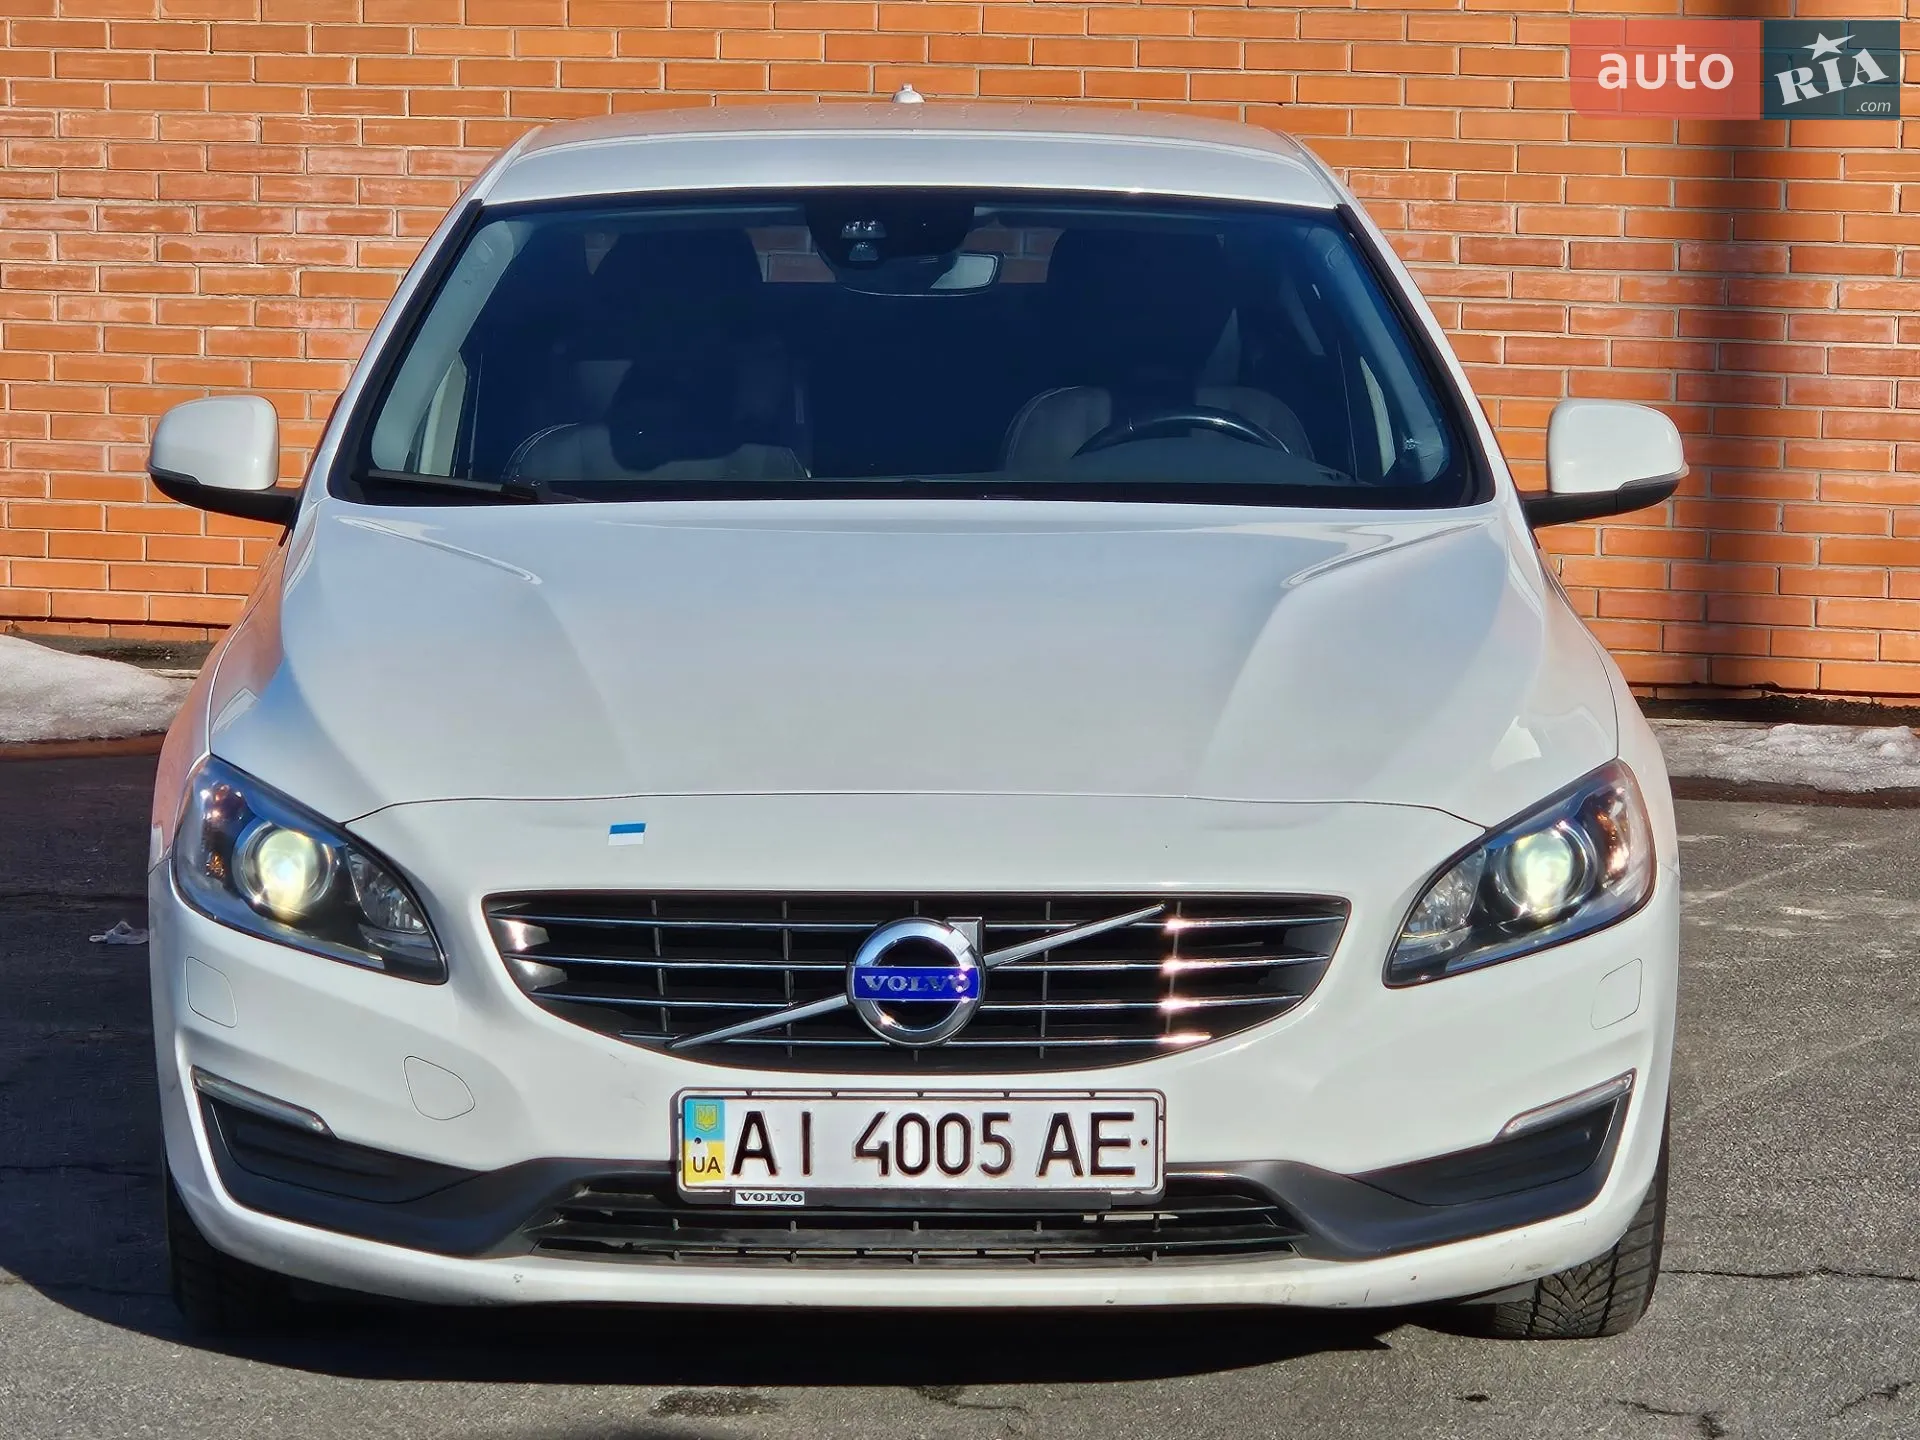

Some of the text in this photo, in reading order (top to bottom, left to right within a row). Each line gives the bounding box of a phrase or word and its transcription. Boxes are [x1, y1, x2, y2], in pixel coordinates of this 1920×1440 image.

[861, 975, 971, 992] VOLVO
[732, 1111, 1136, 1175] AI 4005 AE
[692, 1156, 721, 1174] UA
[737, 1192, 804, 1203] VOLVO
